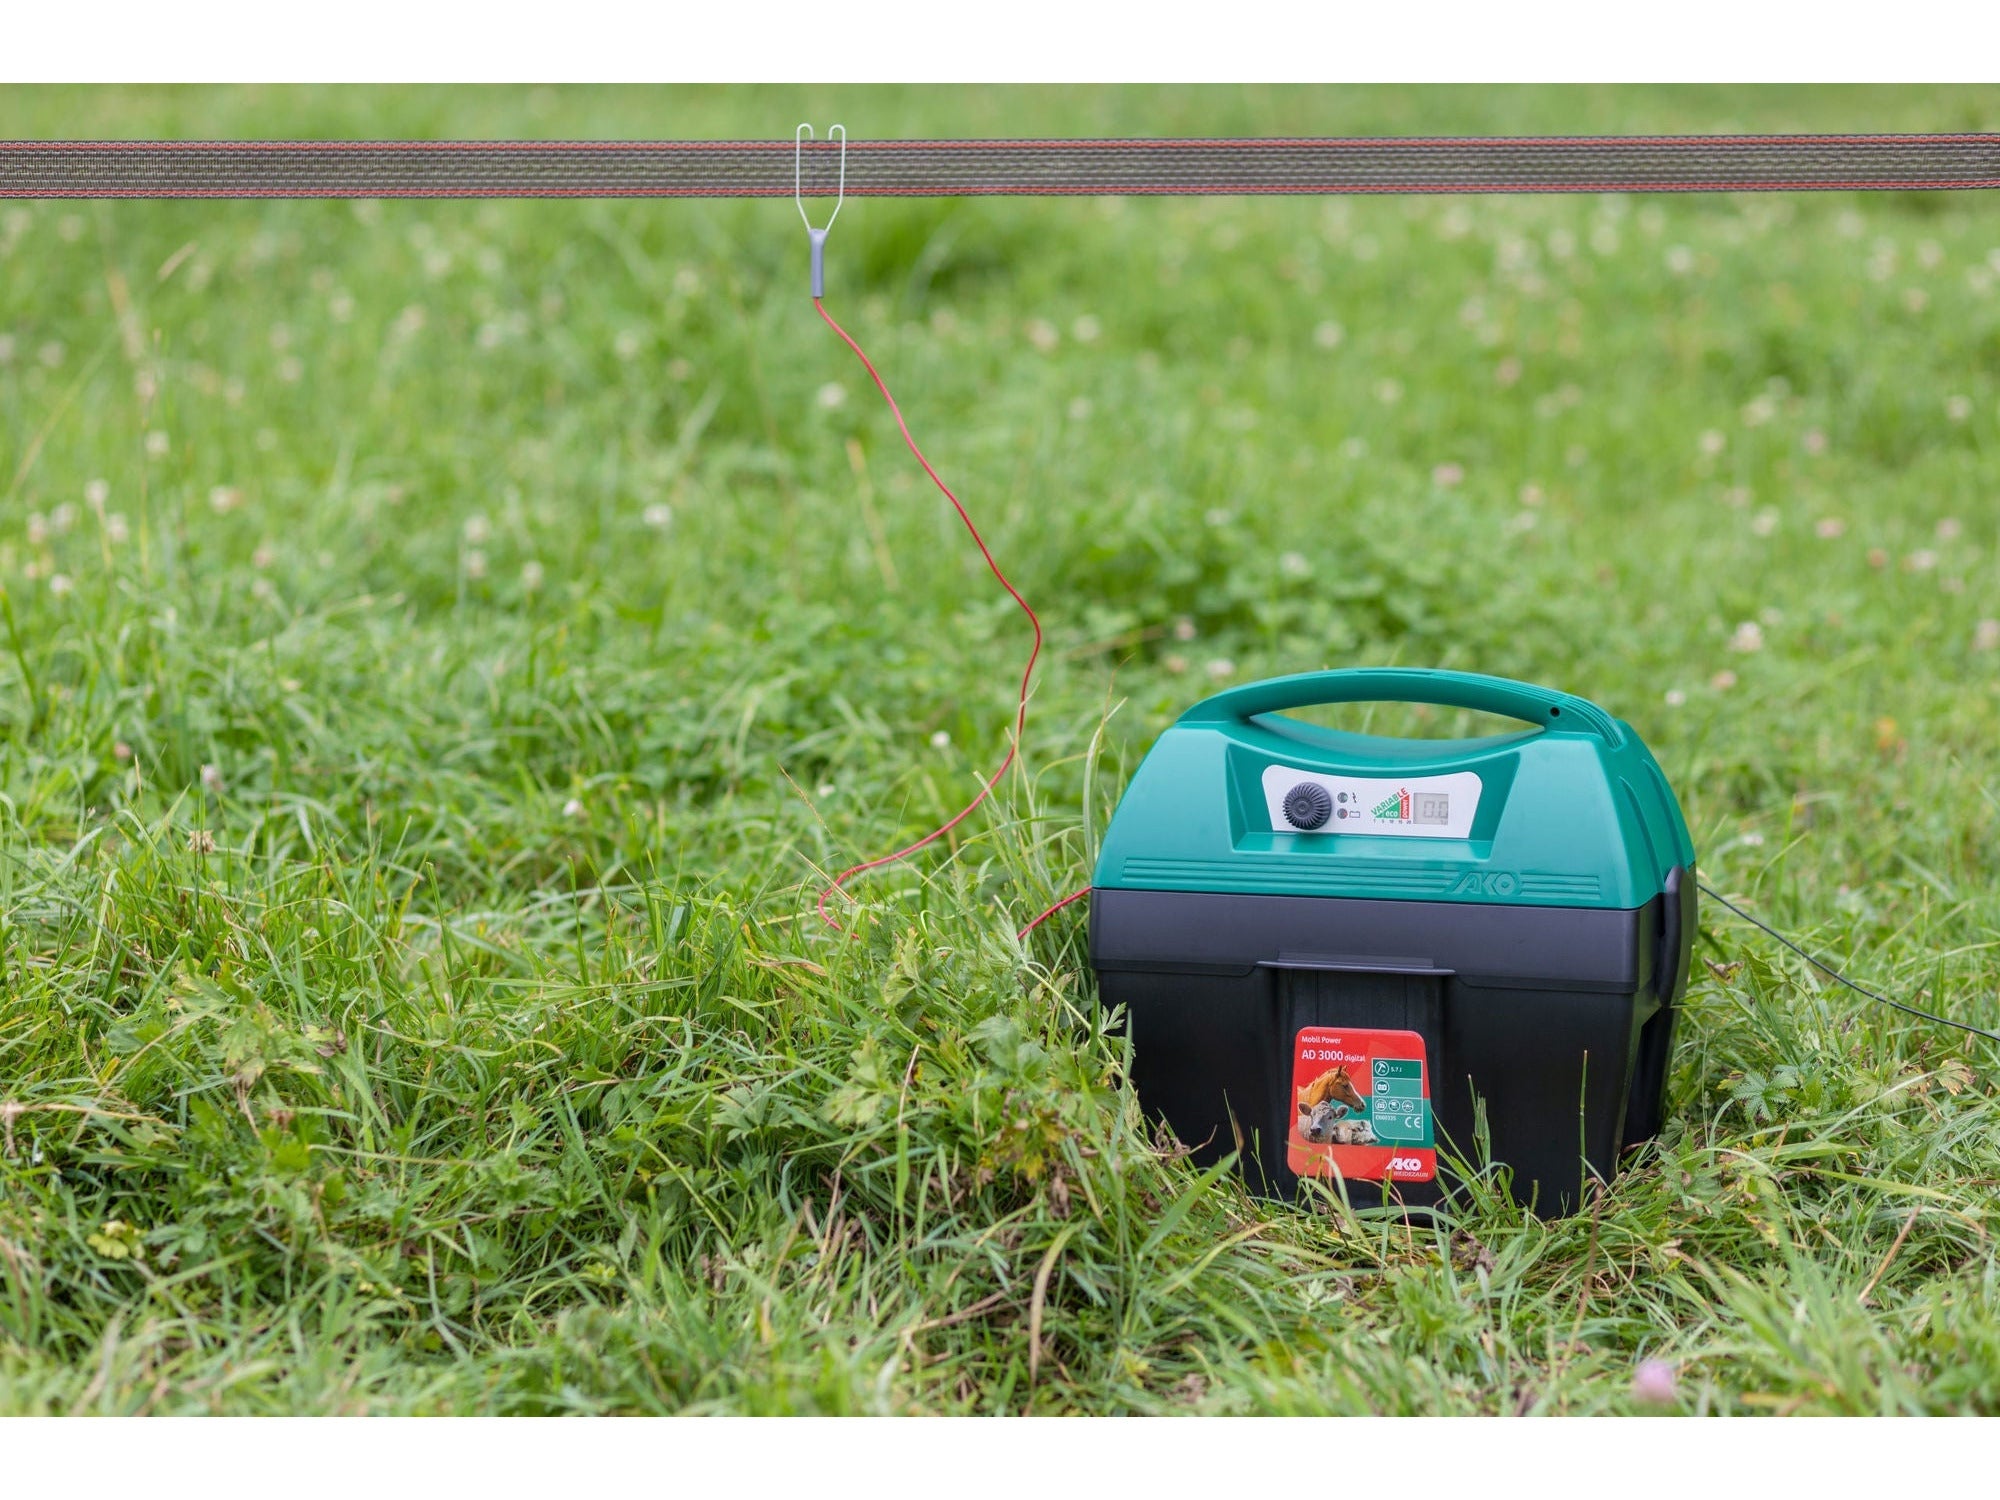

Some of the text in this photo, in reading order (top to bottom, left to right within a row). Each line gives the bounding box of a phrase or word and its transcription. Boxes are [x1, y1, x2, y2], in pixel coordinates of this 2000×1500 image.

[1371, 787, 1408, 816] VARIABLE
[1385, 810, 1398, 818] eco
[1453, 871, 1515, 896] AKO
[1321, 1036, 1341, 1044] Power
[1301, 1049, 1366, 1063] AD 3000 digital
[1404, 1116, 1421, 1128] CE
[1385, 1157, 1422, 1171] AKO
